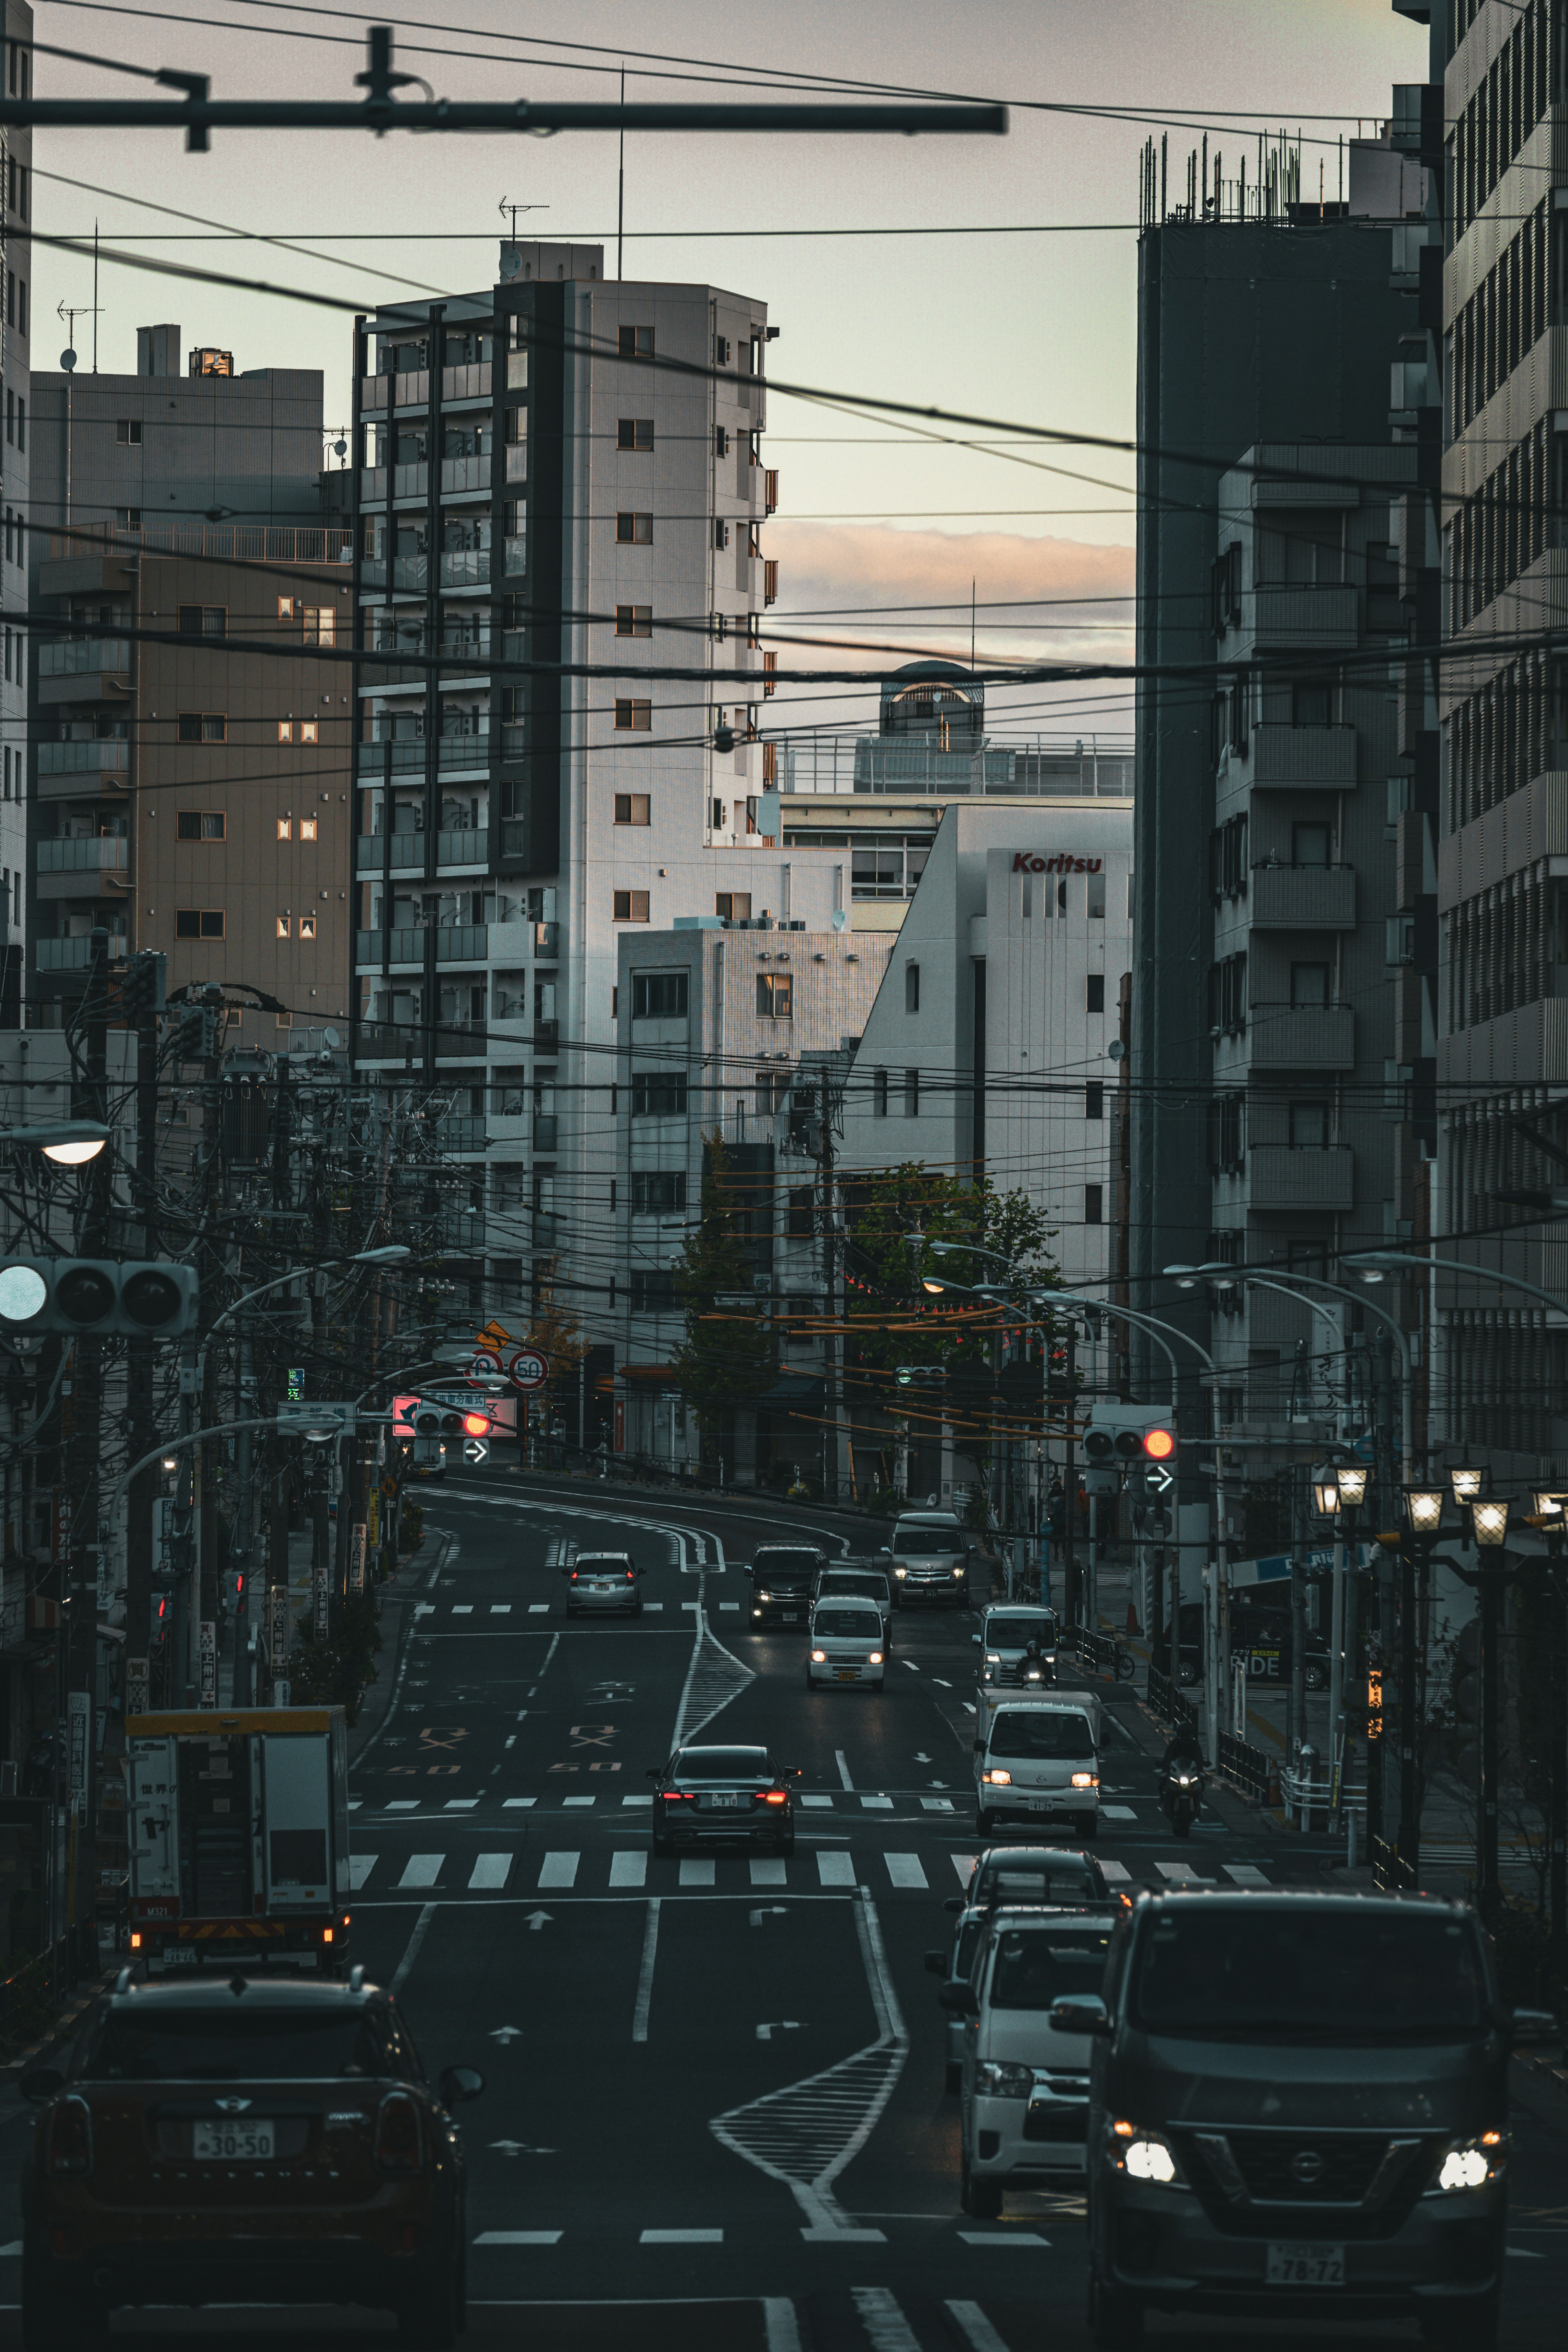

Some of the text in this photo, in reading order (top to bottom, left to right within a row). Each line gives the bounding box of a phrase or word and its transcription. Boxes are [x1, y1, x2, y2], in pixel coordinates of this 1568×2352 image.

[1013, 853, 1102, 873] Koritsu
[518, 1361, 539, 1378] 50
[275, 1588, 285, 1601] 質
[131, 1662, 145, 1677] 質
[1230, 1656, 1279, 1676] RIDE
[71, 1715, 85, 1788] 近藤歯科医院
[384, 1765, 461, 1775] 50
[546, 1762, 622, 1772] 50
[147, 1907, 167, 1916] M321
[171, 1953, 194, 1962] 68-66
[212, 2136, 270, 2156] 30-50
[1283, 2259, 1343, 2281] 78-72
